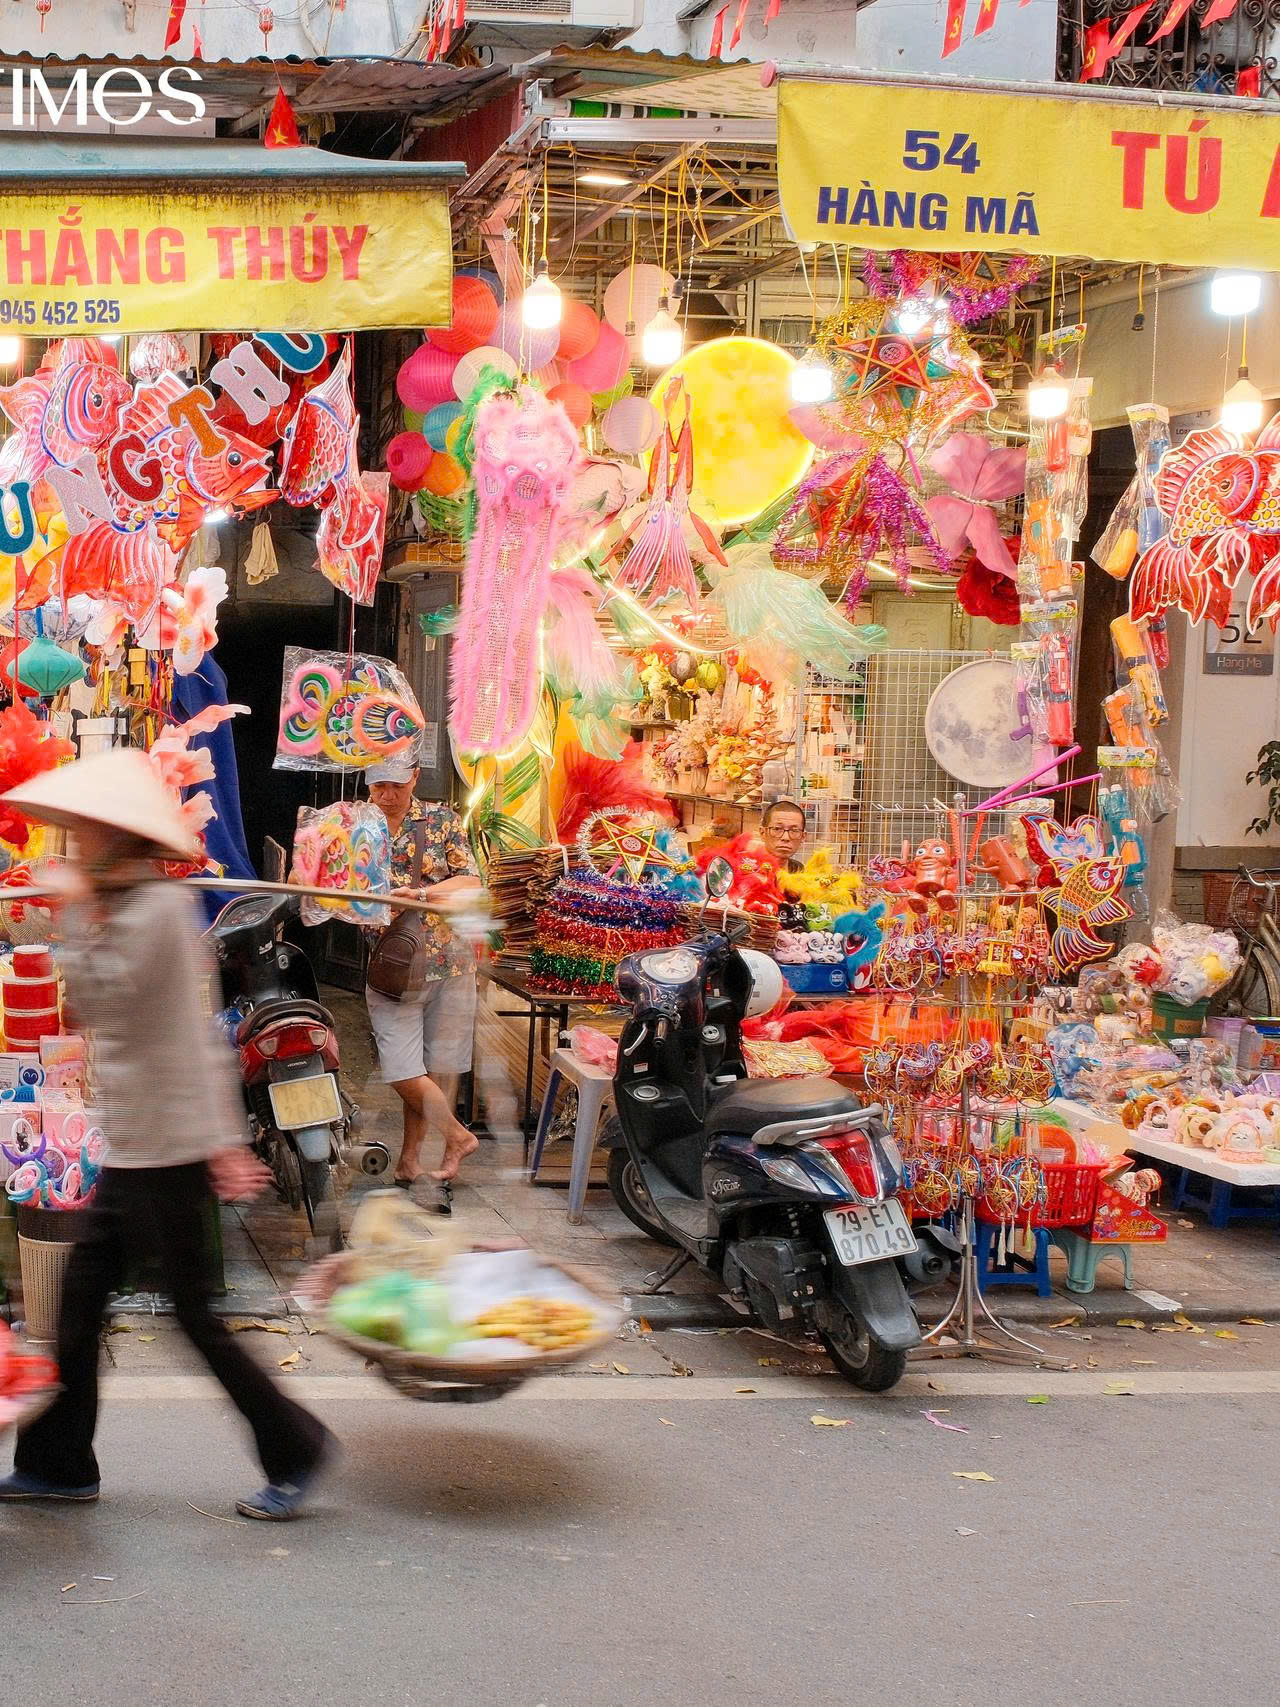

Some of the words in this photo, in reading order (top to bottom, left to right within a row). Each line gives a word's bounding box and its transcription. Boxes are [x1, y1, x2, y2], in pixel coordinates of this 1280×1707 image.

[903, 130, 981, 174] 54
[1112, 119, 1222, 214] TÚ
[817, 180, 948, 231] HÀNG
[964, 192, 1040, 236] MÃ
[207, 212, 369, 284] THÚY
[41, 299, 78, 325] 452
[84, 298, 121, 324] 525
[836, 1203, 895, 1236] 29-E1
[839, 1227, 911, 1262] 870.49
